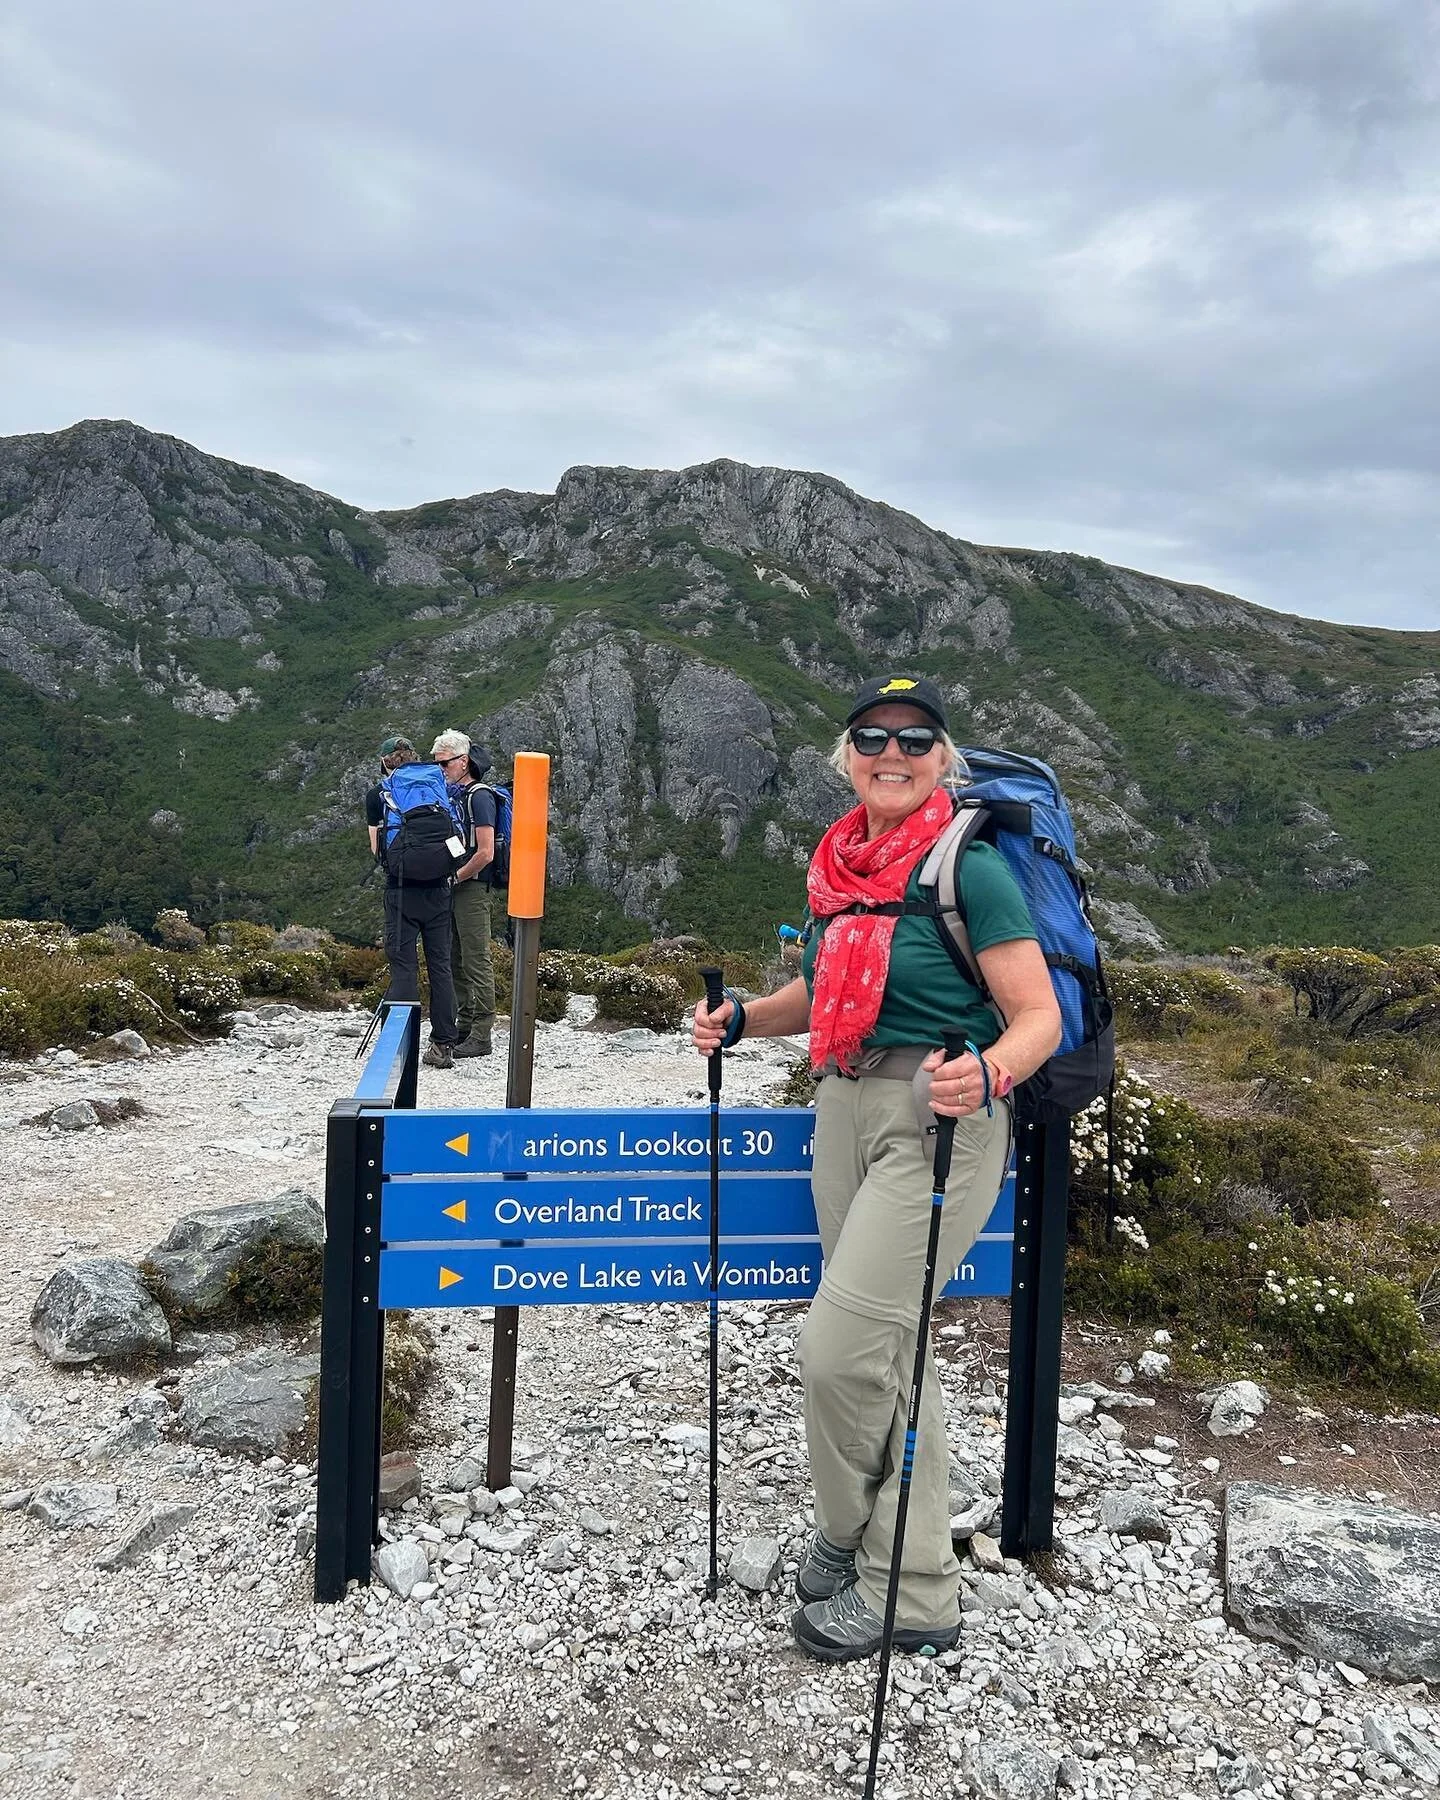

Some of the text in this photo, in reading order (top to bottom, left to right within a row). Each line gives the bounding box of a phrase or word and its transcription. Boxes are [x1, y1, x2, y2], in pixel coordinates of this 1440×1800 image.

[619, 1131, 733, 1156] Lookout
[742, 1130, 773, 1156] 30
[494, 1196, 703, 1224] Overland Track
[492, 1264, 568, 1290] Dove
[579, 1262, 641, 1288] Lake
[650, 1262, 688, 1287] via
[692, 1259, 811, 1287] Wombat
